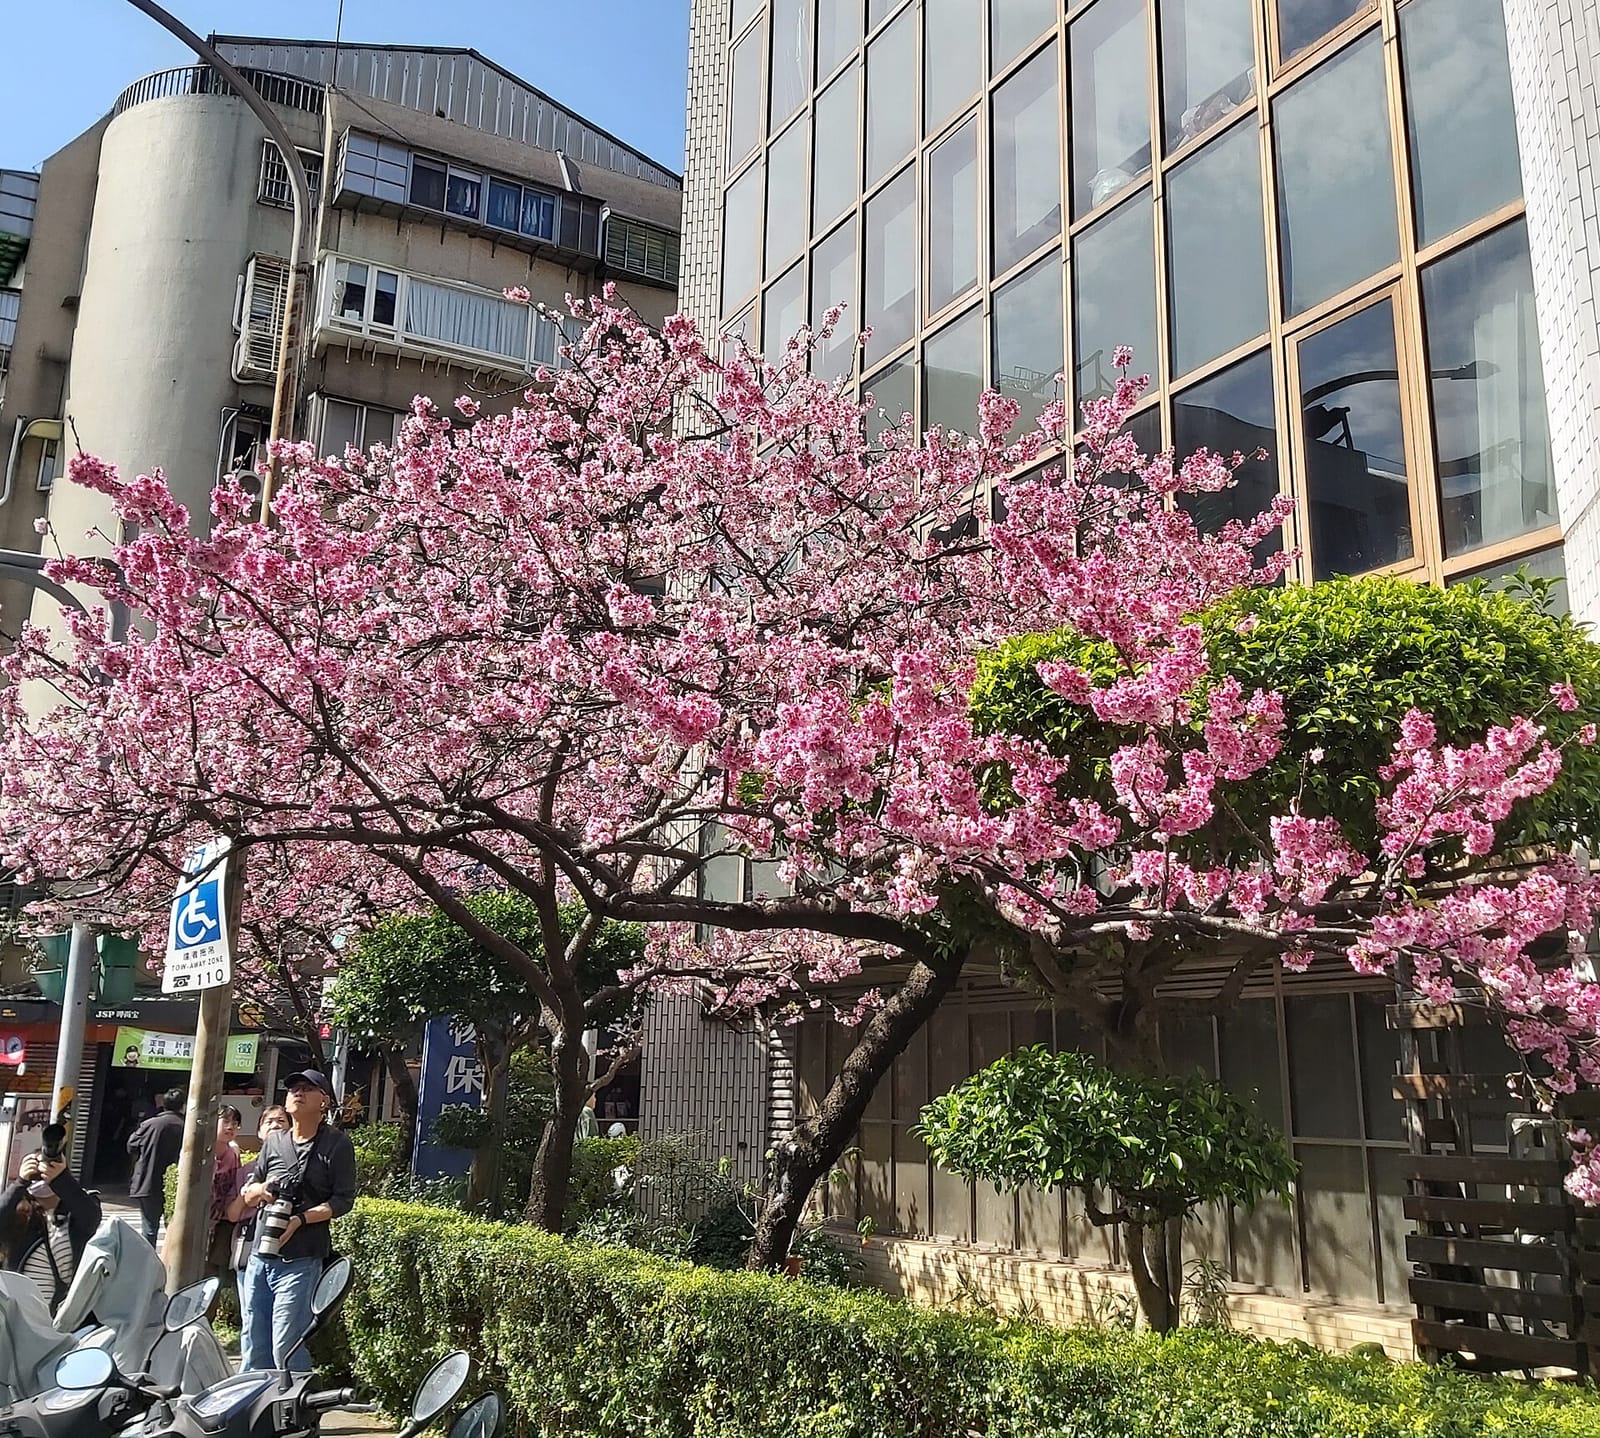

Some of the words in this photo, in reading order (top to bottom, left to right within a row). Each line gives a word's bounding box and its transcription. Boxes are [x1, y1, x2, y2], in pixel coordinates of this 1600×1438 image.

[171, 960, 206, 971] TOW-AWAY
[208, 955, 223, 966] ZONE
[198, 969, 223, 985] 110
[95, 1010, 115, 1018] JSP
[234, 1059, 252, 1067] YOU
